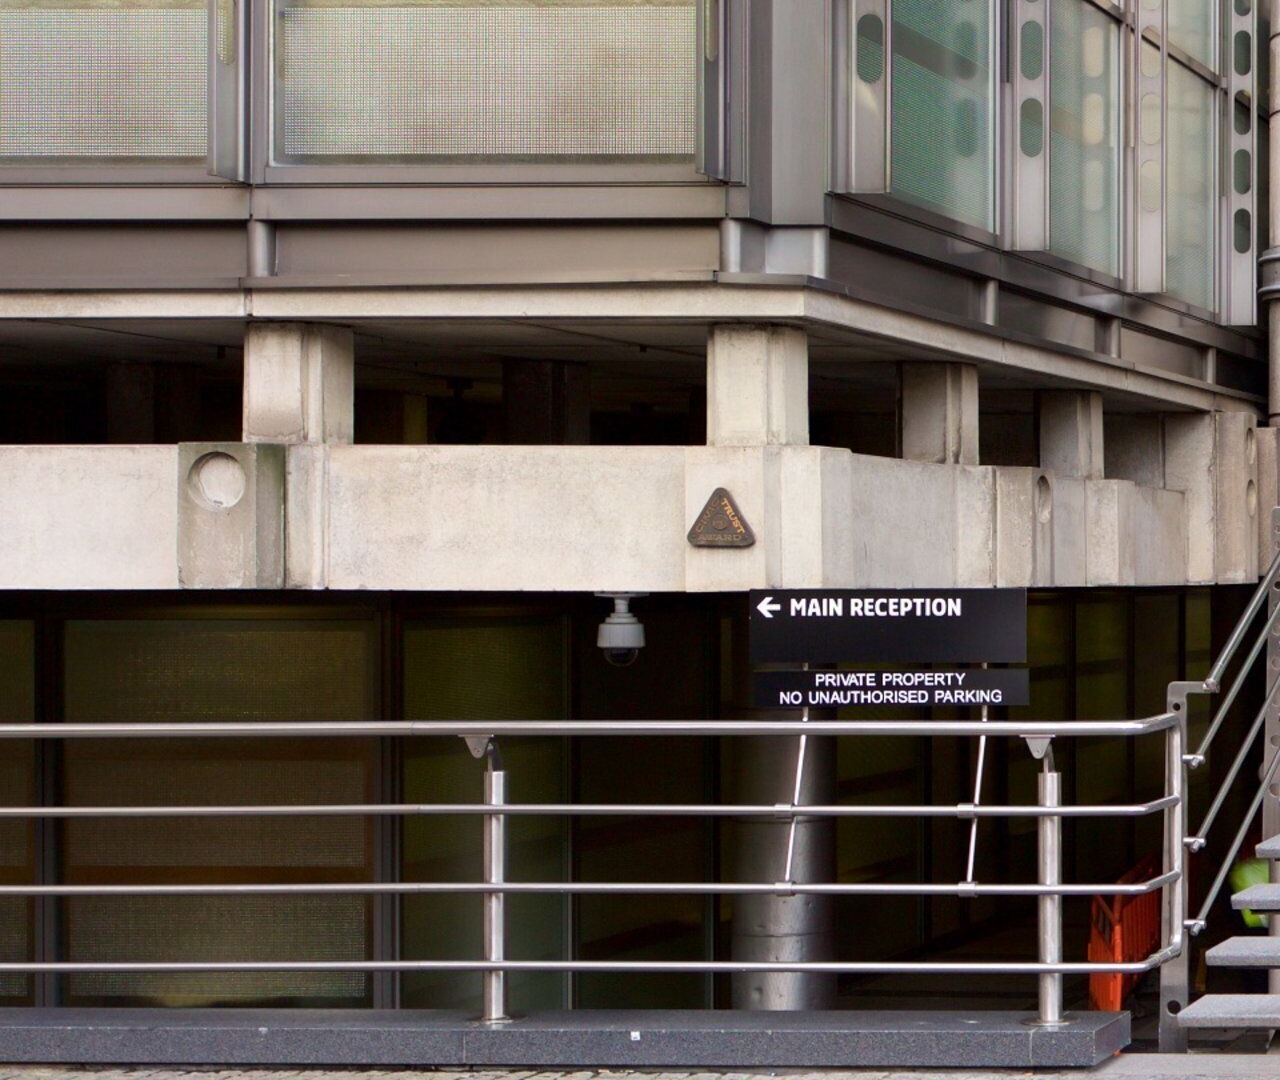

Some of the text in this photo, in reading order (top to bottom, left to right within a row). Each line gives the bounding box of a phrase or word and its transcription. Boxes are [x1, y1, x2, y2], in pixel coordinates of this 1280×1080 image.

[721, 497, 746, 535] TRUST
[790, 598, 962, 617] MAIN RECEPTION
[815, 672, 966, 687] PRIVATE PROPERTY
[779, 689, 1003, 705] NO UNAUTHORISED PARKING
